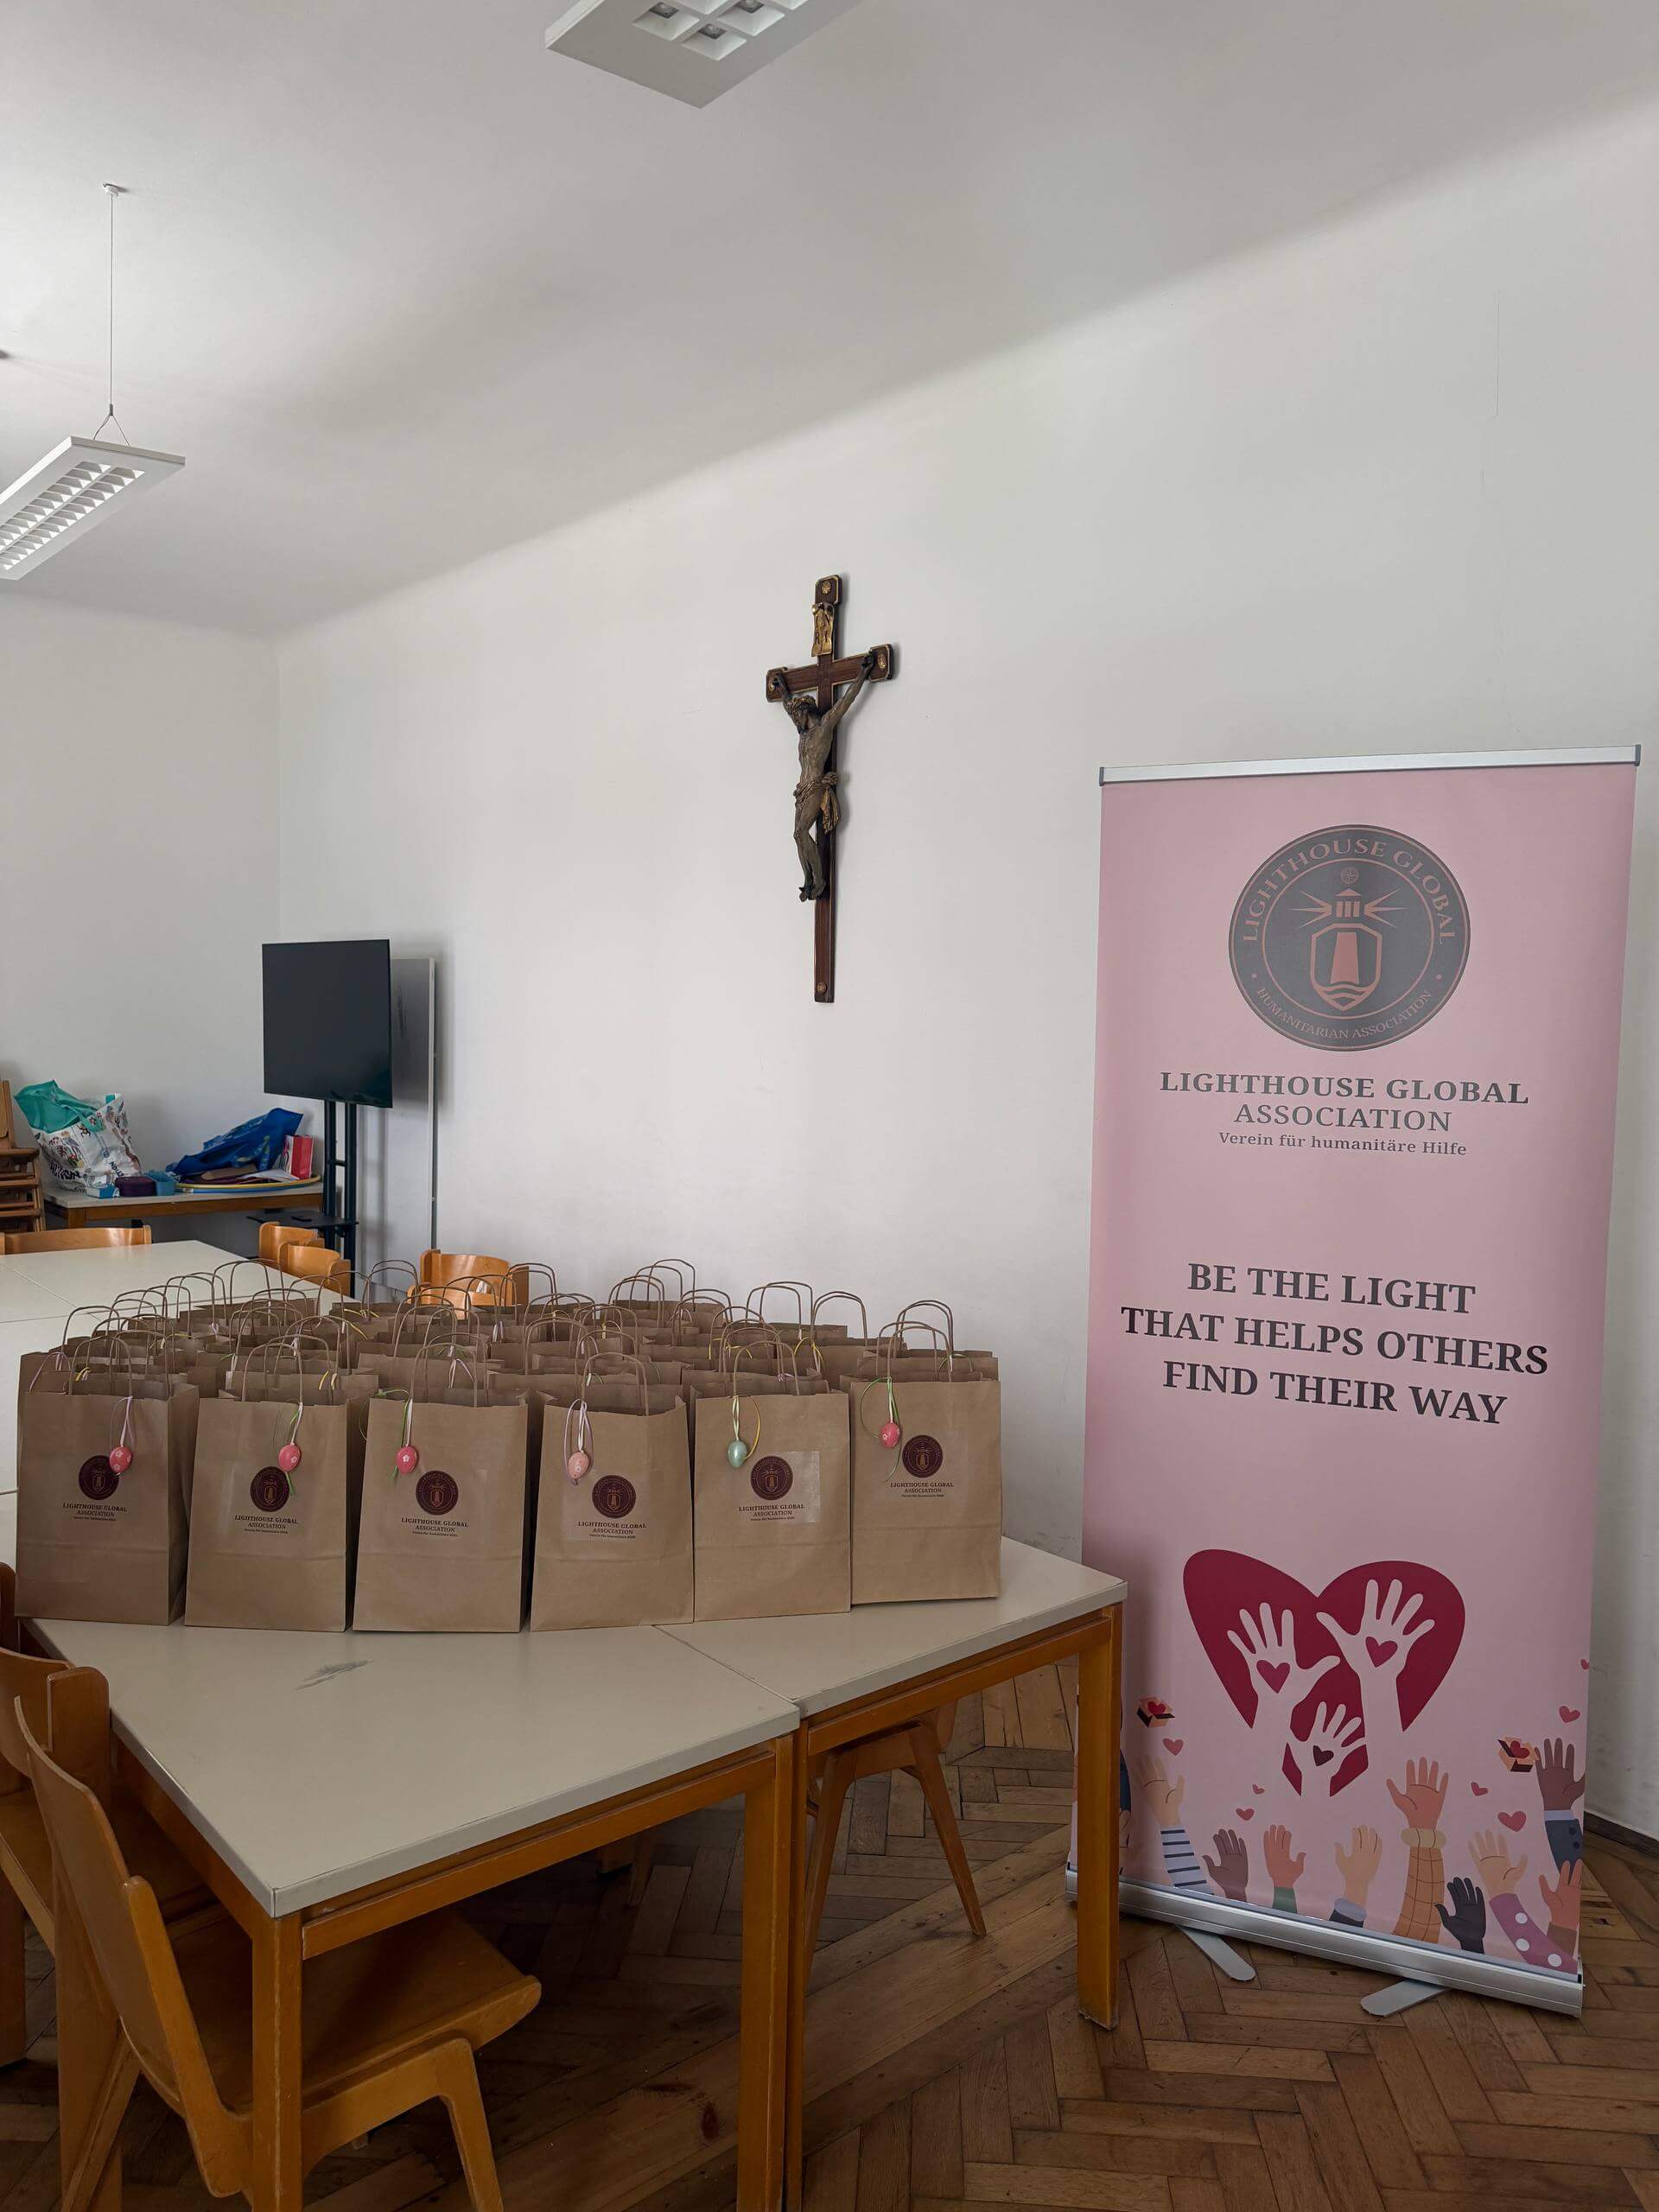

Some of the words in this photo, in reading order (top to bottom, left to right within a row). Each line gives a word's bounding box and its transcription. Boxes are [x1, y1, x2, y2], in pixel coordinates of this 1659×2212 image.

[1243, 839, 1387, 941] LIGHTHOUSE
[1393, 850, 1455, 944] GLOBAL
[1257, 988, 1349, 1039] HUMANITARIAN
[1352, 990, 1432, 1039] ASSOCIATION
[1160, 1071, 1375, 1098] LIGHTHOUSE
[1386, 1078, 1529, 1104] GLOBAL
[1219, 1132, 1274, 1146] Verein
[1279, 1134, 1306, 1147] für
[1311, 1135, 1416, 1153] humanitäre
[1422, 1141, 1467, 1155] Hilfe
[1234, 1104, 1452, 1132] ASSOCIATION
[1187, 1262, 1236, 1294] BE
[1248, 1268, 1330, 1302] THE
[1341, 1274, 1476, 1314] LIGHT
[1121, 1306, 1224, 1341] THAT
[1235, 1317, 1363, 1356] HELPS
[1377, 1331, 1548, 1375] OTHERS
[1163, 1361, 1258, 1395] FIND
[1270, 1371, 1398, 1412] THEIR
[1409, 1386, 1508, 1424] WAY
